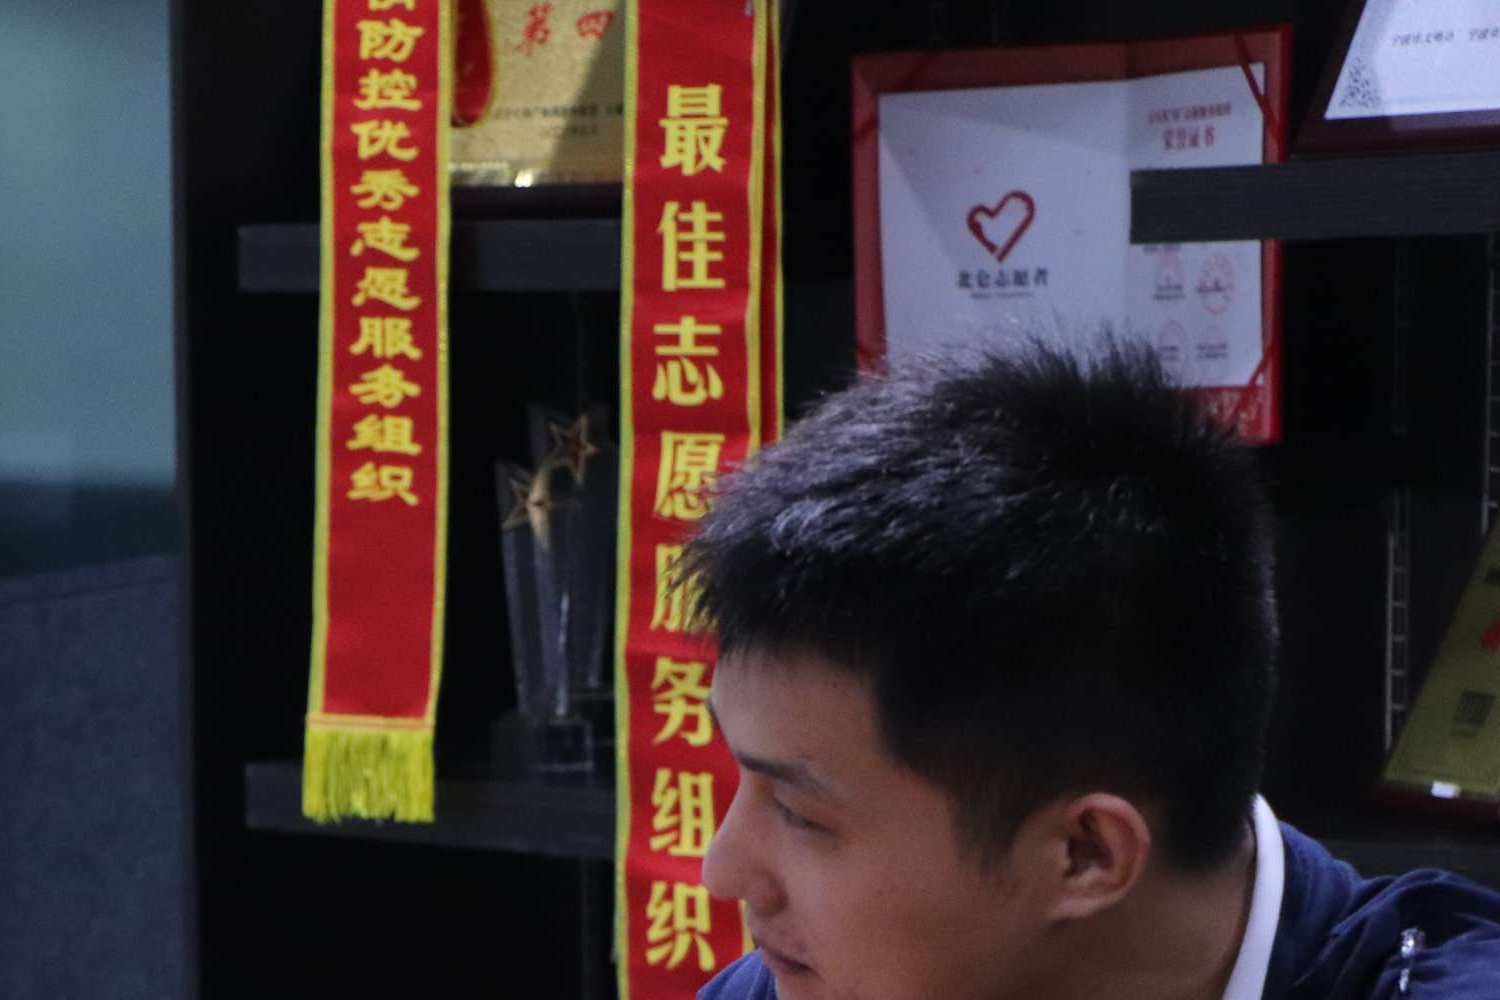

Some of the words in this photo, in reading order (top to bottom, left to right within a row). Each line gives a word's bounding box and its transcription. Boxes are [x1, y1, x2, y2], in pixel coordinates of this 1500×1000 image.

[349, 0, 425, 506] 防控优秀志愿服务组织
